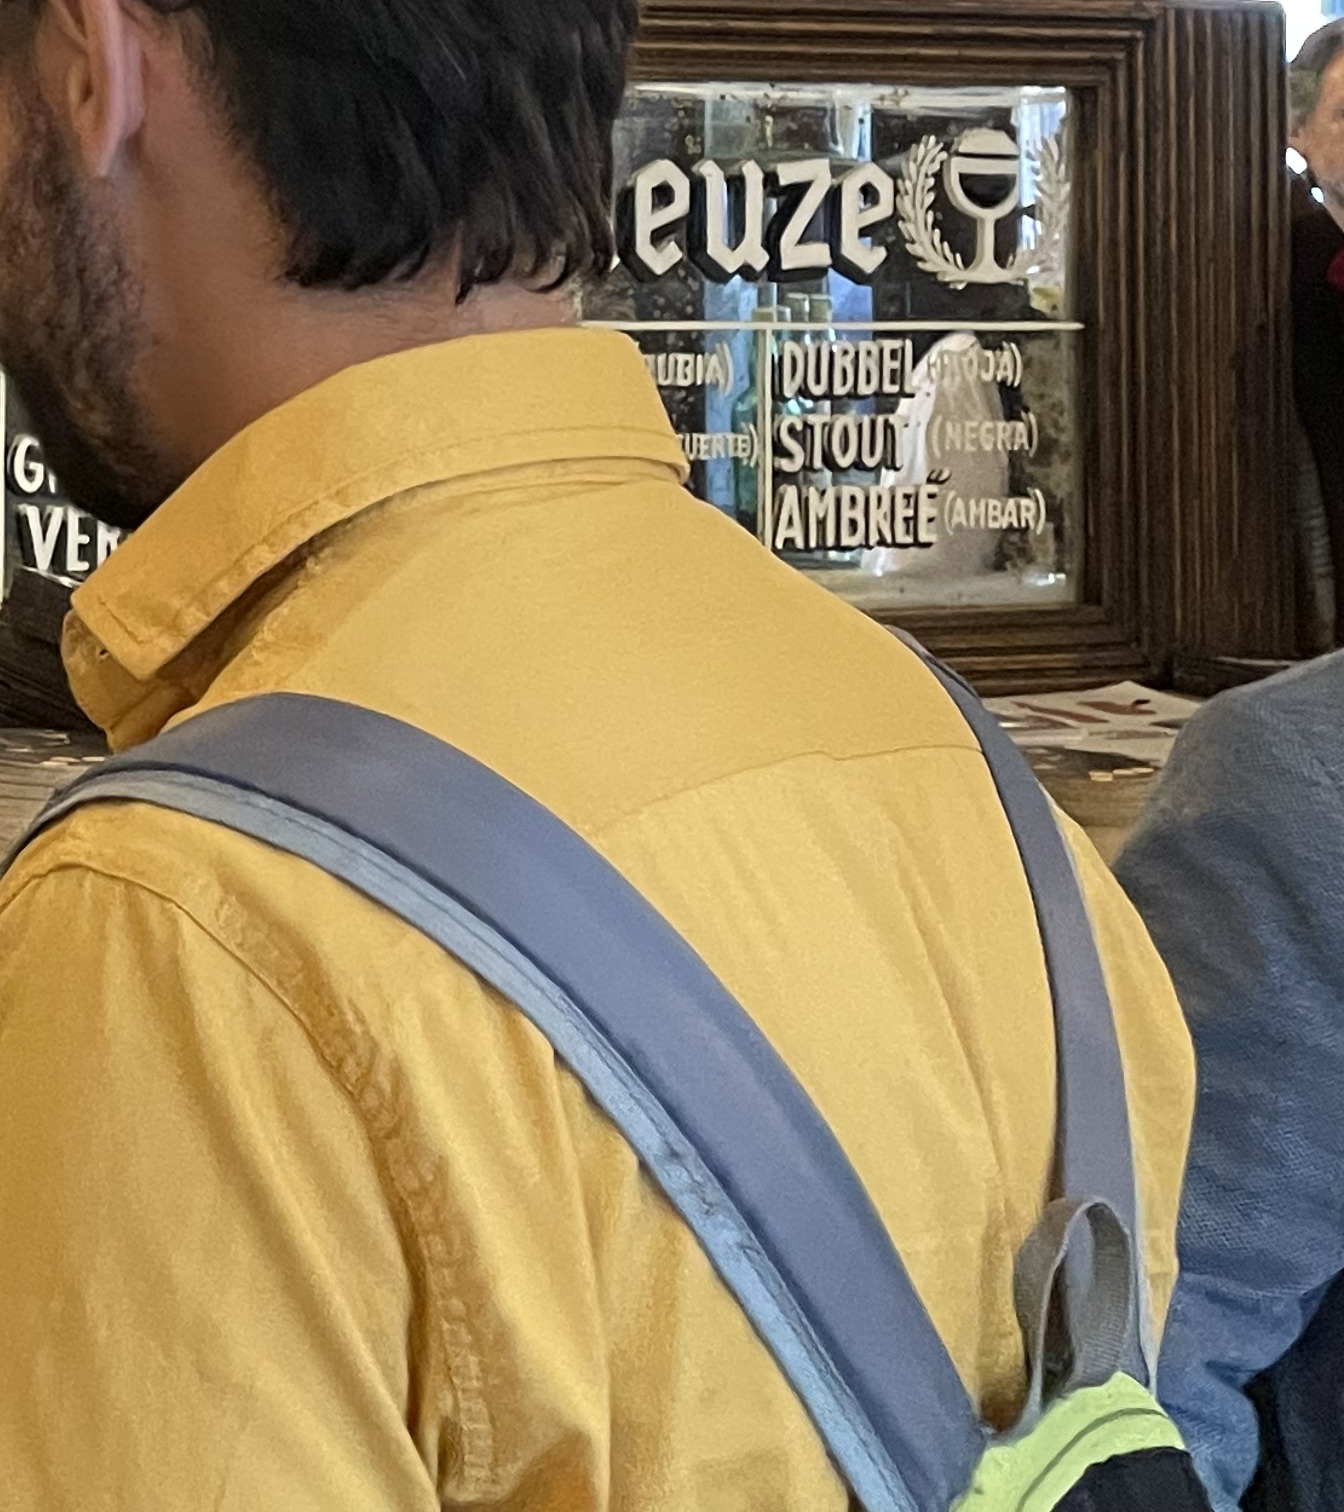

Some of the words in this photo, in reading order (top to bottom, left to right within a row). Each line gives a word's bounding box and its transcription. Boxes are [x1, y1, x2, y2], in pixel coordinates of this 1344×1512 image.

[635, 158, 895, 276] euze
[782, 338, 916, 397] DUBBEL
[11, 436, 58, 494] G
[777, 414, 909, 470] STOUT
[932, 411, 1039, 459] (NEGRA)
[943, 486, 1047, 536] (AMBAR)
